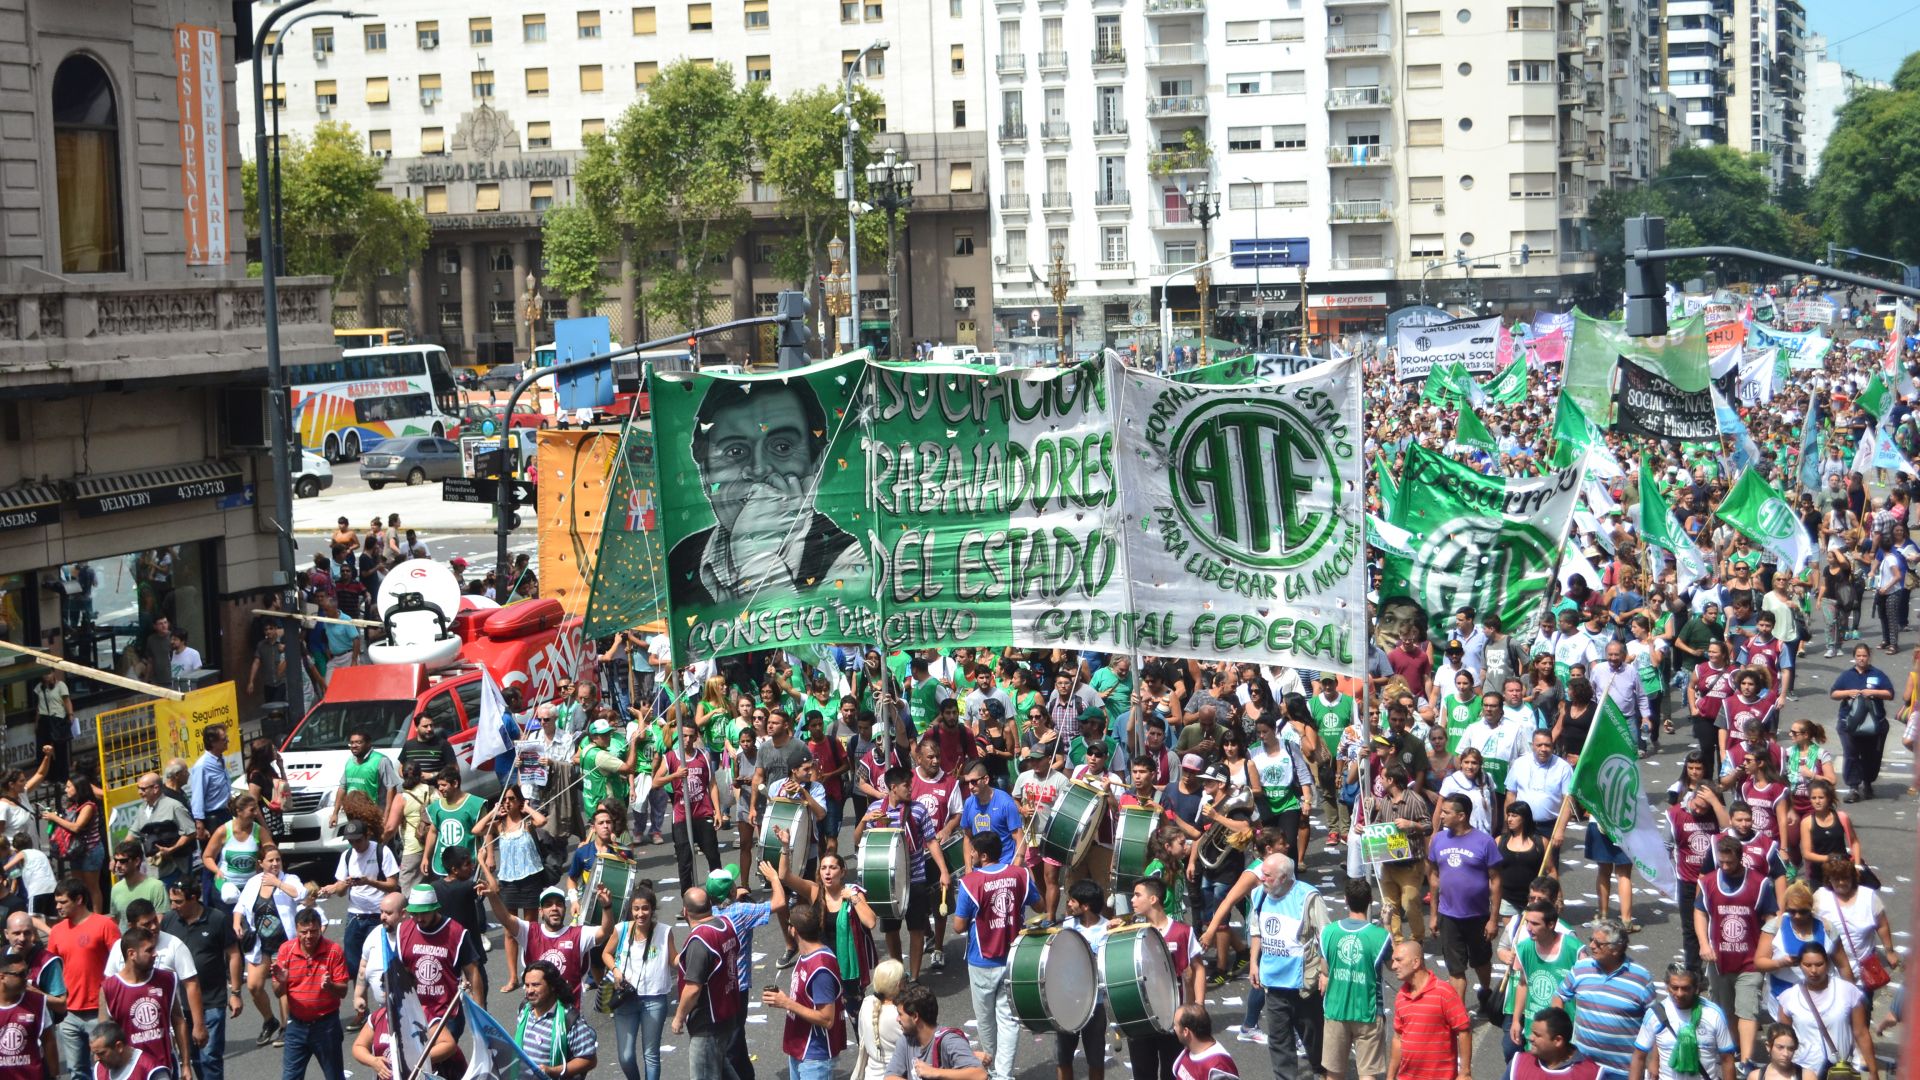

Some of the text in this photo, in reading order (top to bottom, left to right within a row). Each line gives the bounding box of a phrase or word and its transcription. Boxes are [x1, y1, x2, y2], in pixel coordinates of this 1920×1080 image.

[179, 29, 200, 259] RESIDENCIA
[201, 32, 222, 259] UNIVERSITARIA
[406, 157, 568, 182] SENADO DE LA NACION
[429, 217, 469, 229] NADOR
[1337, 295, 1373, 304] express
[1447, 323, 1480, 332] INTERNA
[1755, 329, 1806, 351] SUTEBA
[1401, 352, 1465, 365] PROMOCION
[1627, 388, 1665, 412] SOCIAL
[1294, 386, 1354, 459] ESTADO
[445, 485, 476, 494] Rivadavia
[446, 478, 471, 486] Avenida
[1181, 411, 1320, 555] ATE
[99, 480, 226, 512] DELIVERY 4373-2733
[867, 526, 1116, 602] DEL ESTADO
[1153, 505, 1361, 602] PARA LIBERAR LA NACION
[687, 603, 829, 655] CONSEJO
[1034, 609, 1354, 664] CAPITAL FEDERAL
[192, 704, 229, 724] Seguimos
[983, 877, 1017, 893] ORGANIZACION
[1265, 919, 1281, 935] ATE
[412, 943, 449, 959] ORGANIZACION
